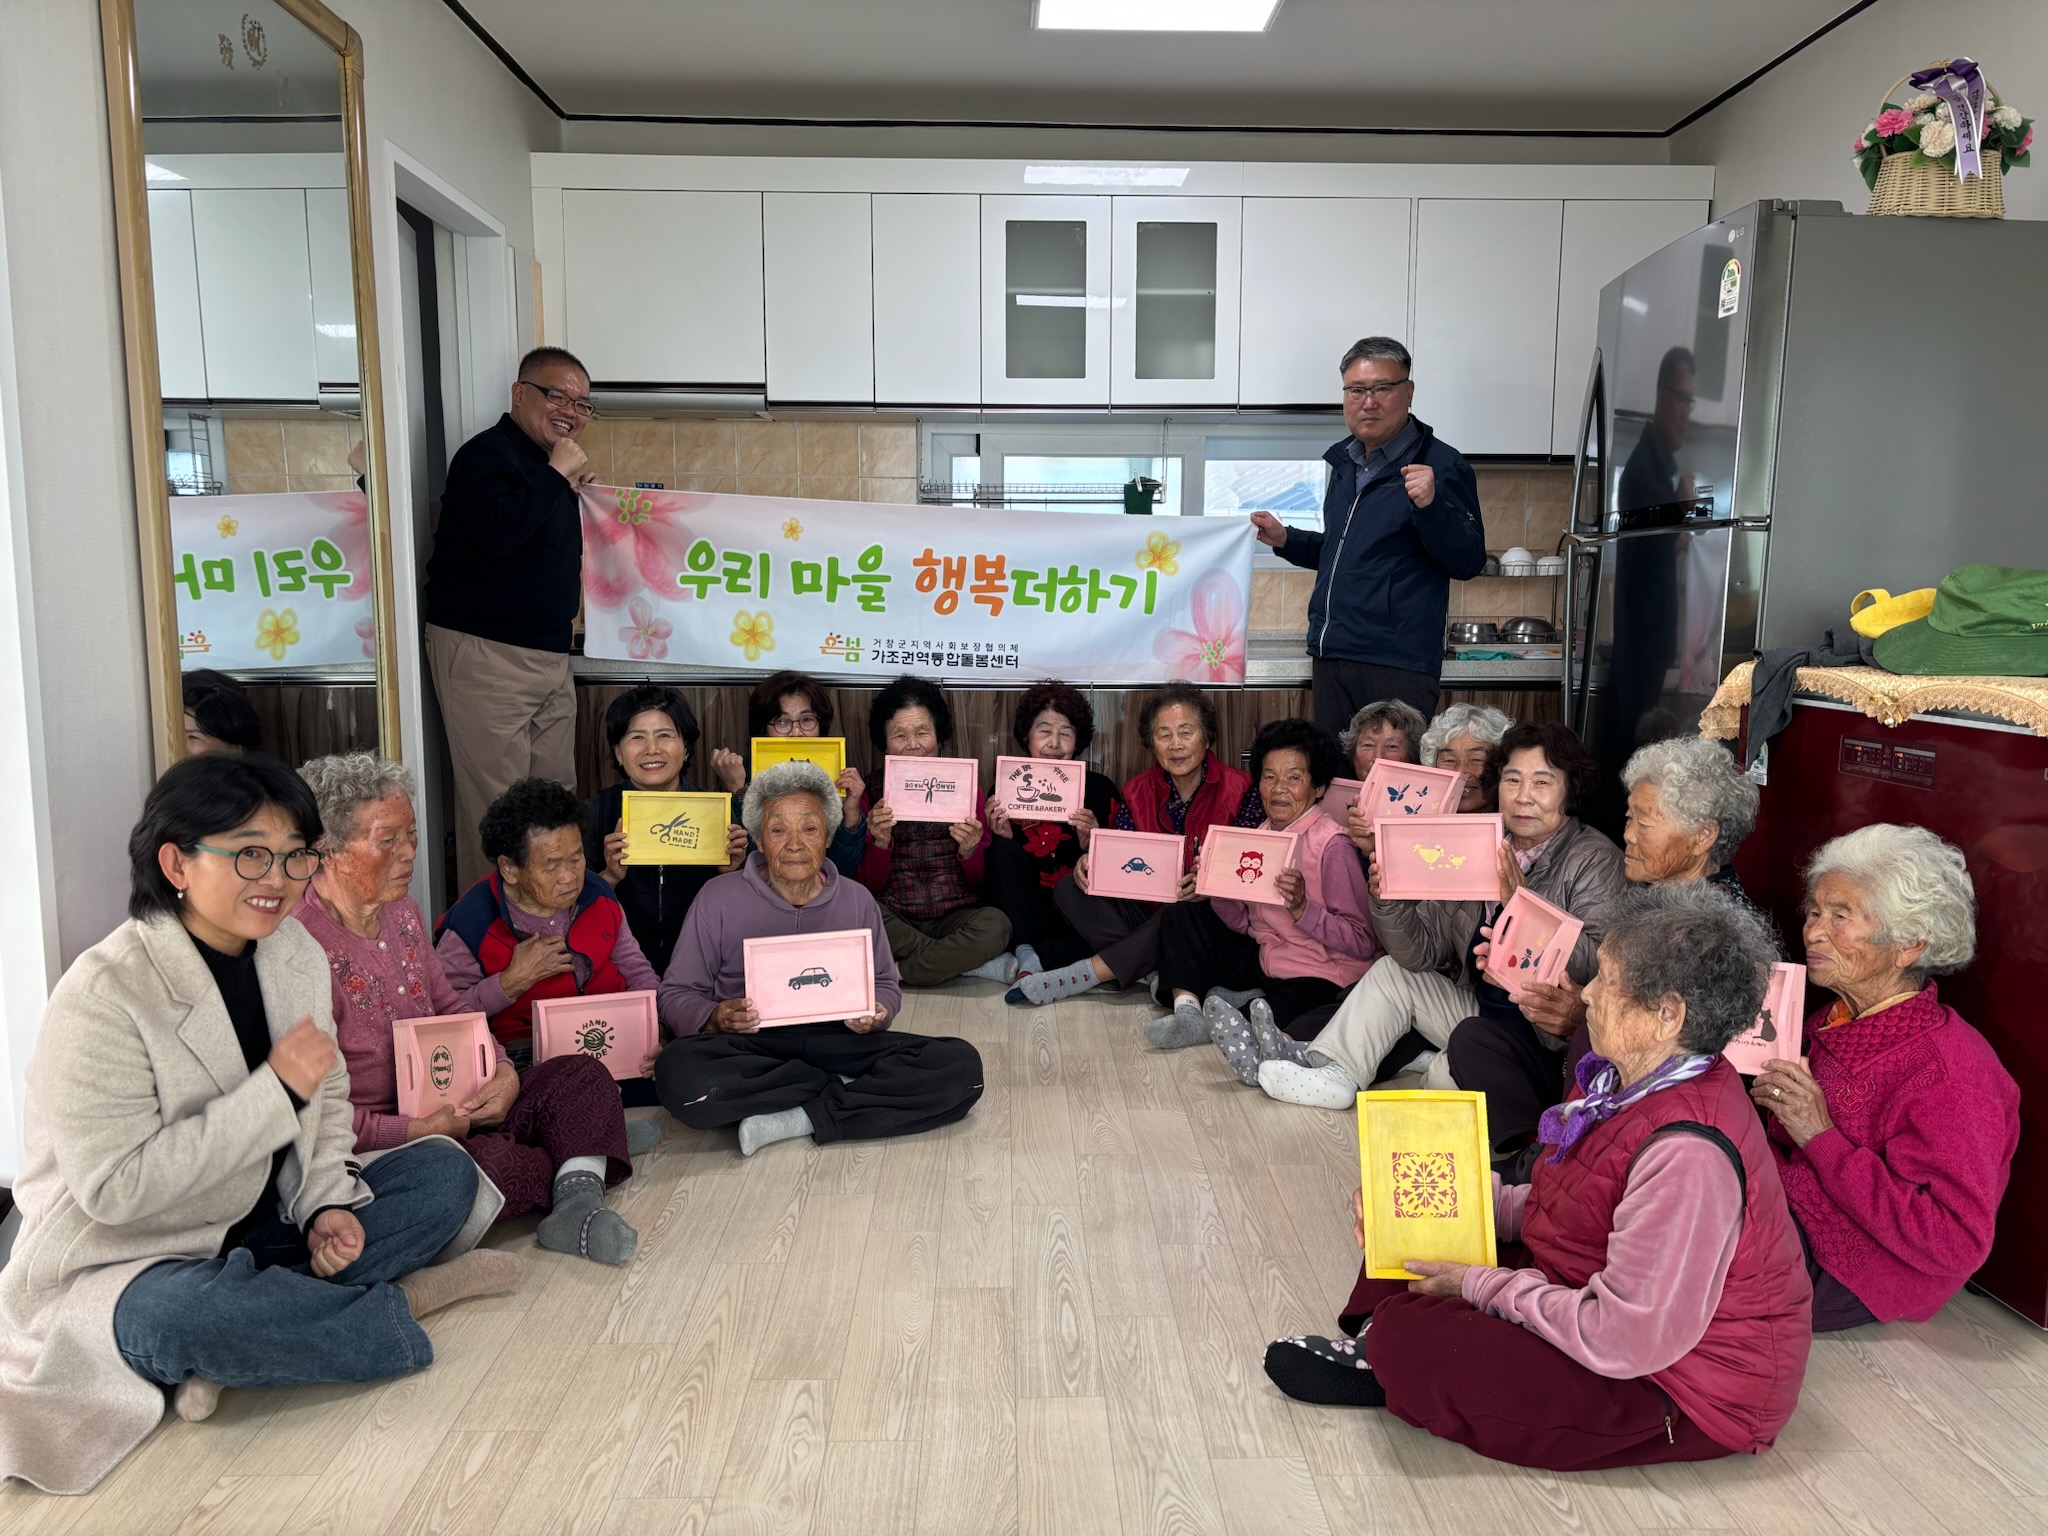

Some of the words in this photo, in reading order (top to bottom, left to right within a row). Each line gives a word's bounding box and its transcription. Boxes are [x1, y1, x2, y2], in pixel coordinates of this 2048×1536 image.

[1736, 226, 1745, 238] LG
[680, 540, 770, 600] 우리
[791, 544, 892, 612] 마을
[871, 650, 1020, 669] 가조권역통합돌봄센터
[1009, 768, 1022, 782] THE
[582, 1019, 608, 1030] HAND
